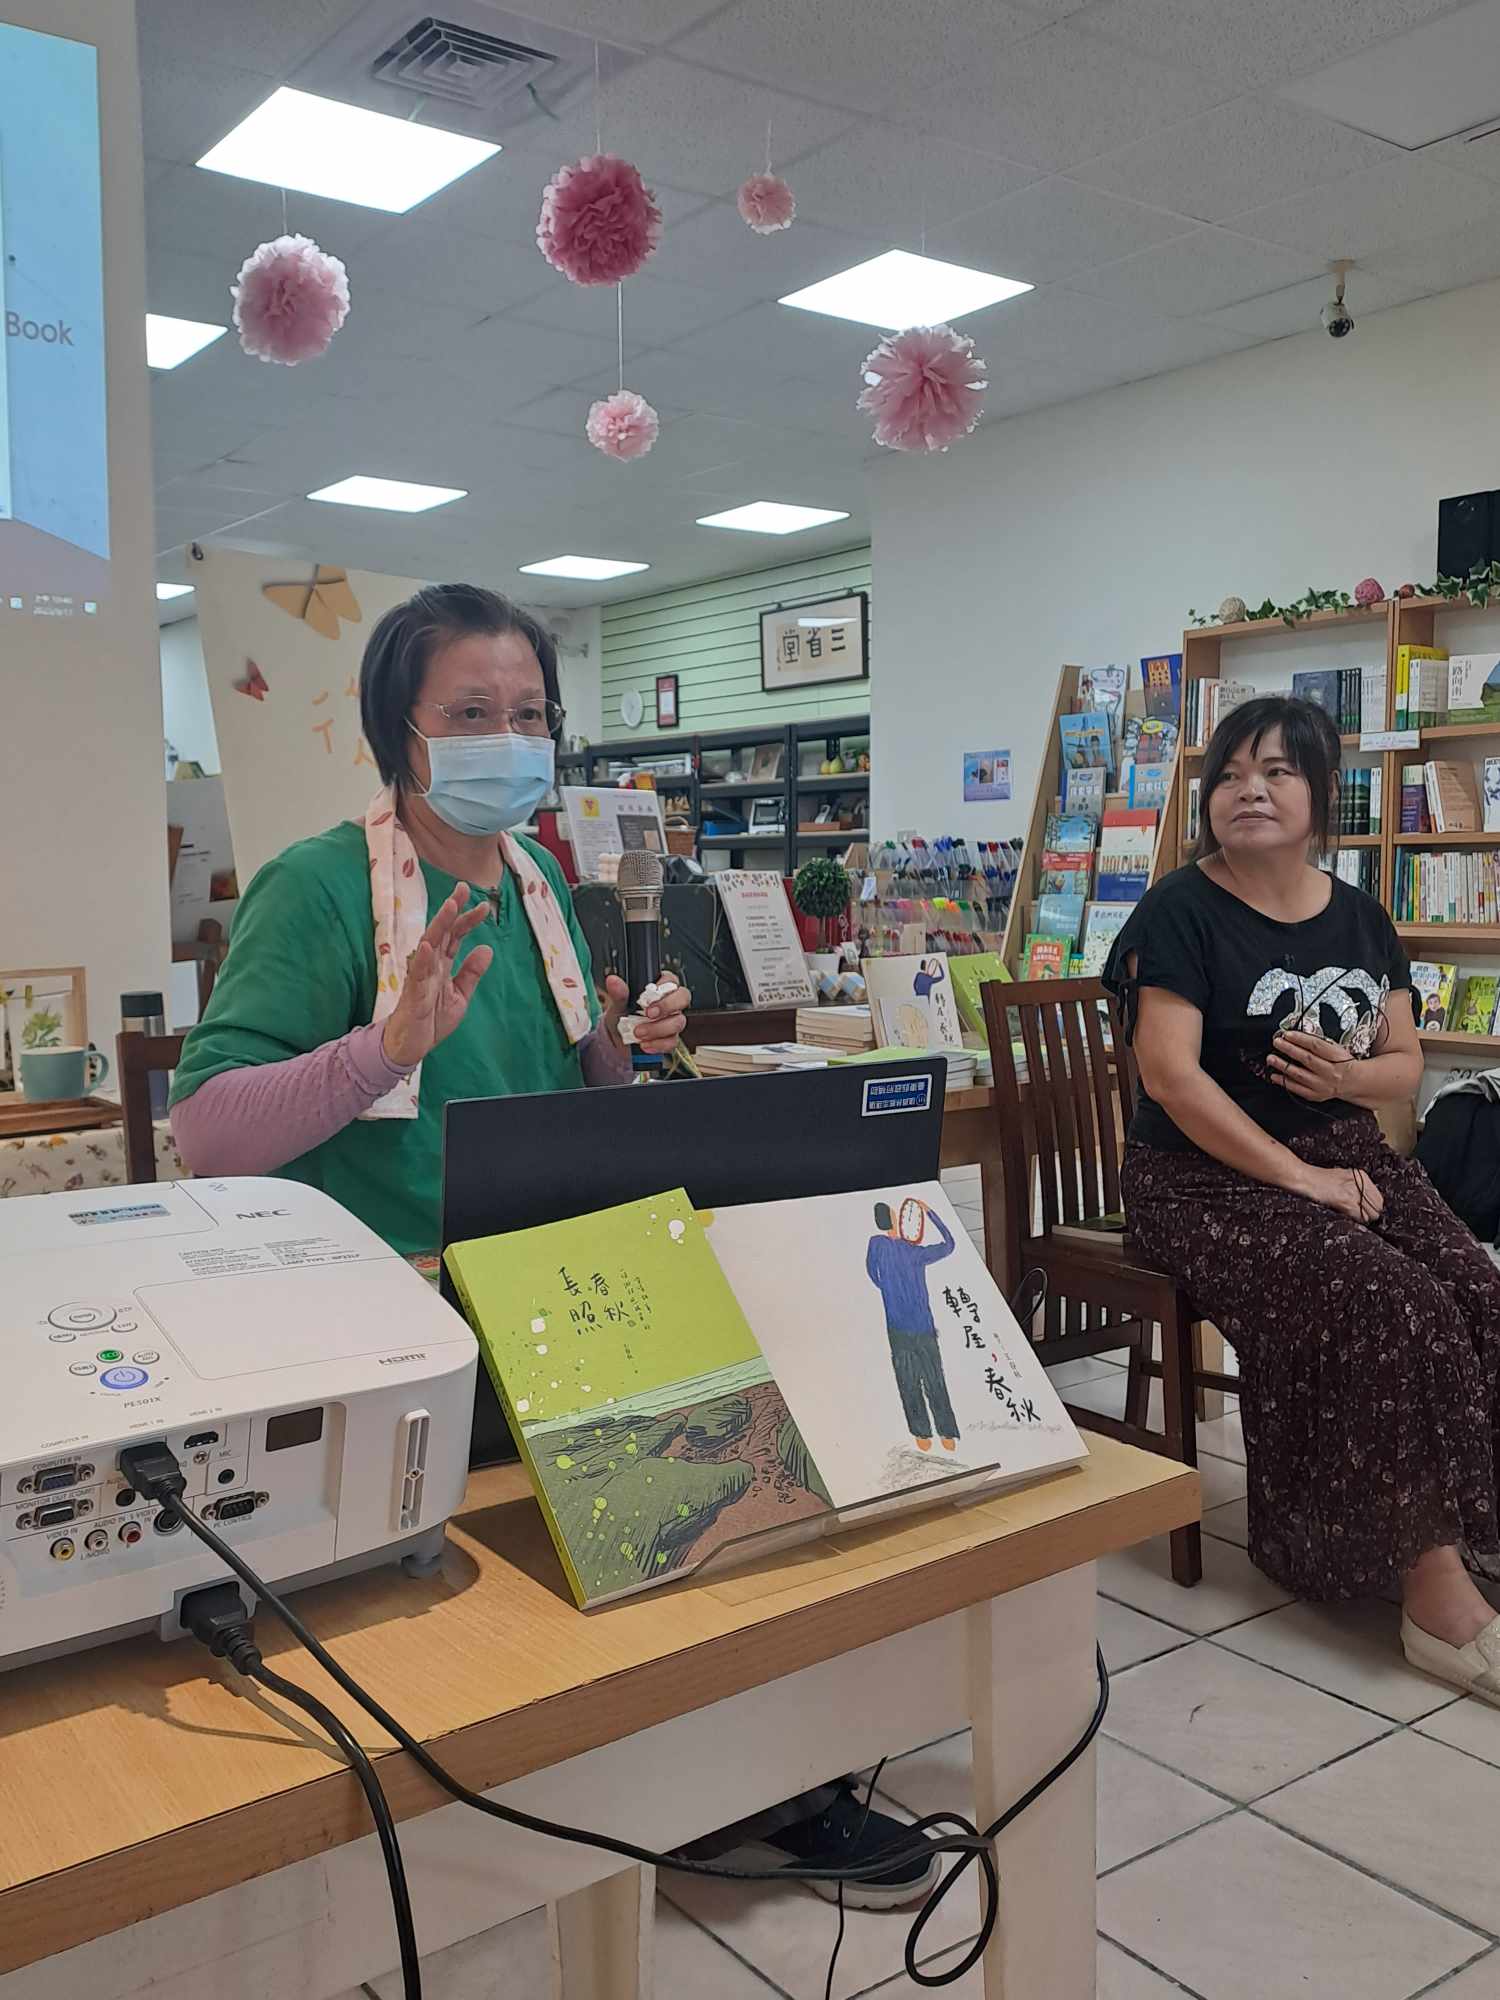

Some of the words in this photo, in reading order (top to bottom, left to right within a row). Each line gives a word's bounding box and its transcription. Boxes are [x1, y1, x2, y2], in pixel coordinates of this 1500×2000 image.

[6, 310, 74, 347] Book
[235, 1209, 294, 1220] NEC
[378, 1352, 427, 1365] HDMI
[123, 1396, 162, 1409] PE501X
